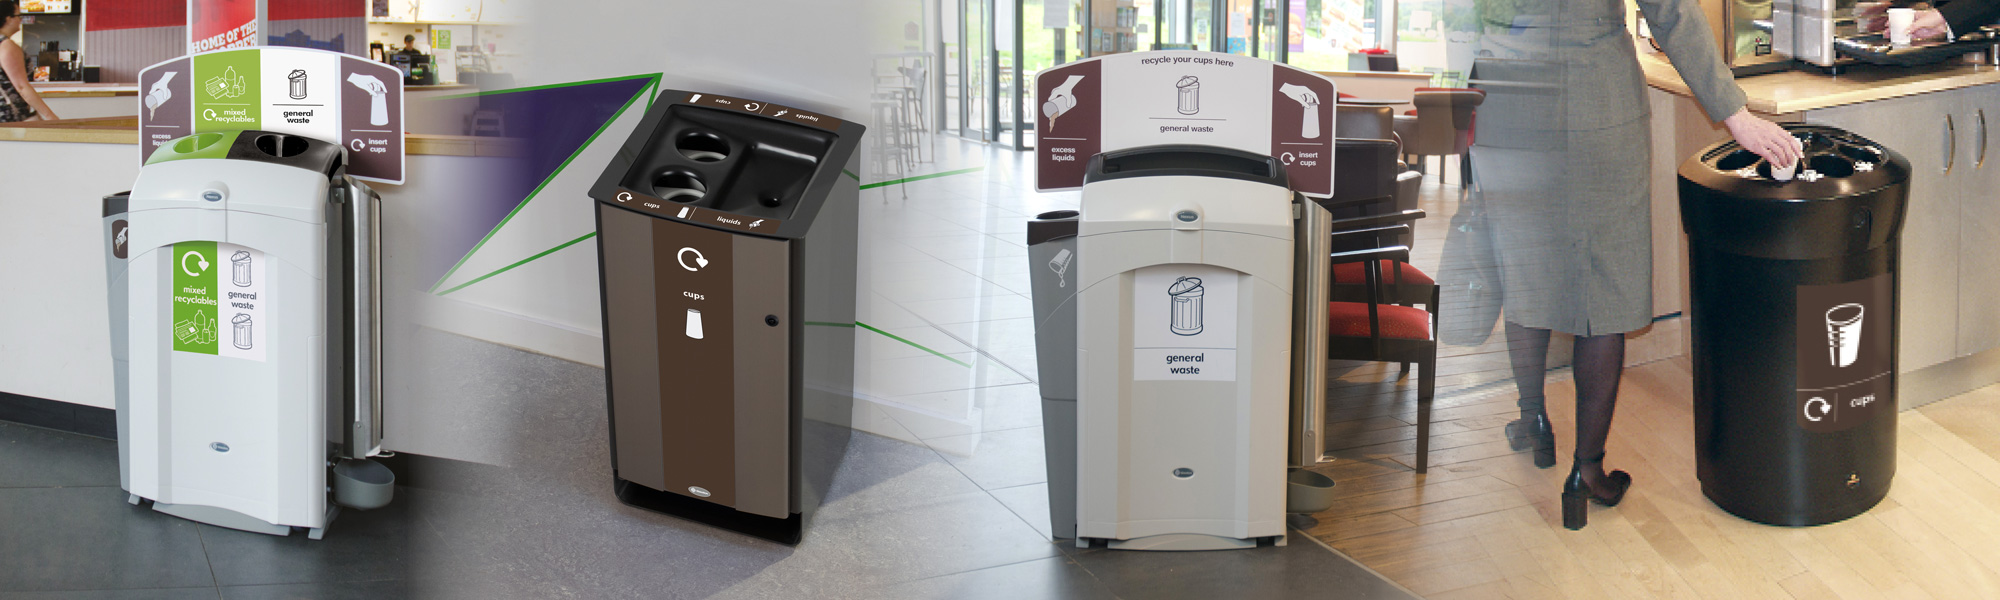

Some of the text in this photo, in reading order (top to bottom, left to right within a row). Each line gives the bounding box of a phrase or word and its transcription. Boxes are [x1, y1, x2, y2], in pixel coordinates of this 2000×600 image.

[192, 18, 257, 54] HOME OF THE
[1141, 56, 1234, 67] recycle your cups here
[224, 108, 246, 116] mixed
[283, 109, 314, 118] general
[215, 115, 255, 123] recyclables
[795, 113, 819, 122] liquids
[1160, 125, 1190, 133] general
[1052, 154, 1075, 162] liquids
[716, 216, 742, 226] liquids
[183, 285, 207, 295] mixed
[228, 291, 257, 300] general
[683, 291, 705, 300] cups
[174, 295, 218, 306] recyclables
[231, 301, 254, 310] waste
[1166, 352, 1204, 364] general
[1170, 366, 1200, 374] waste
[1850, 394, 1875, 407] cups
